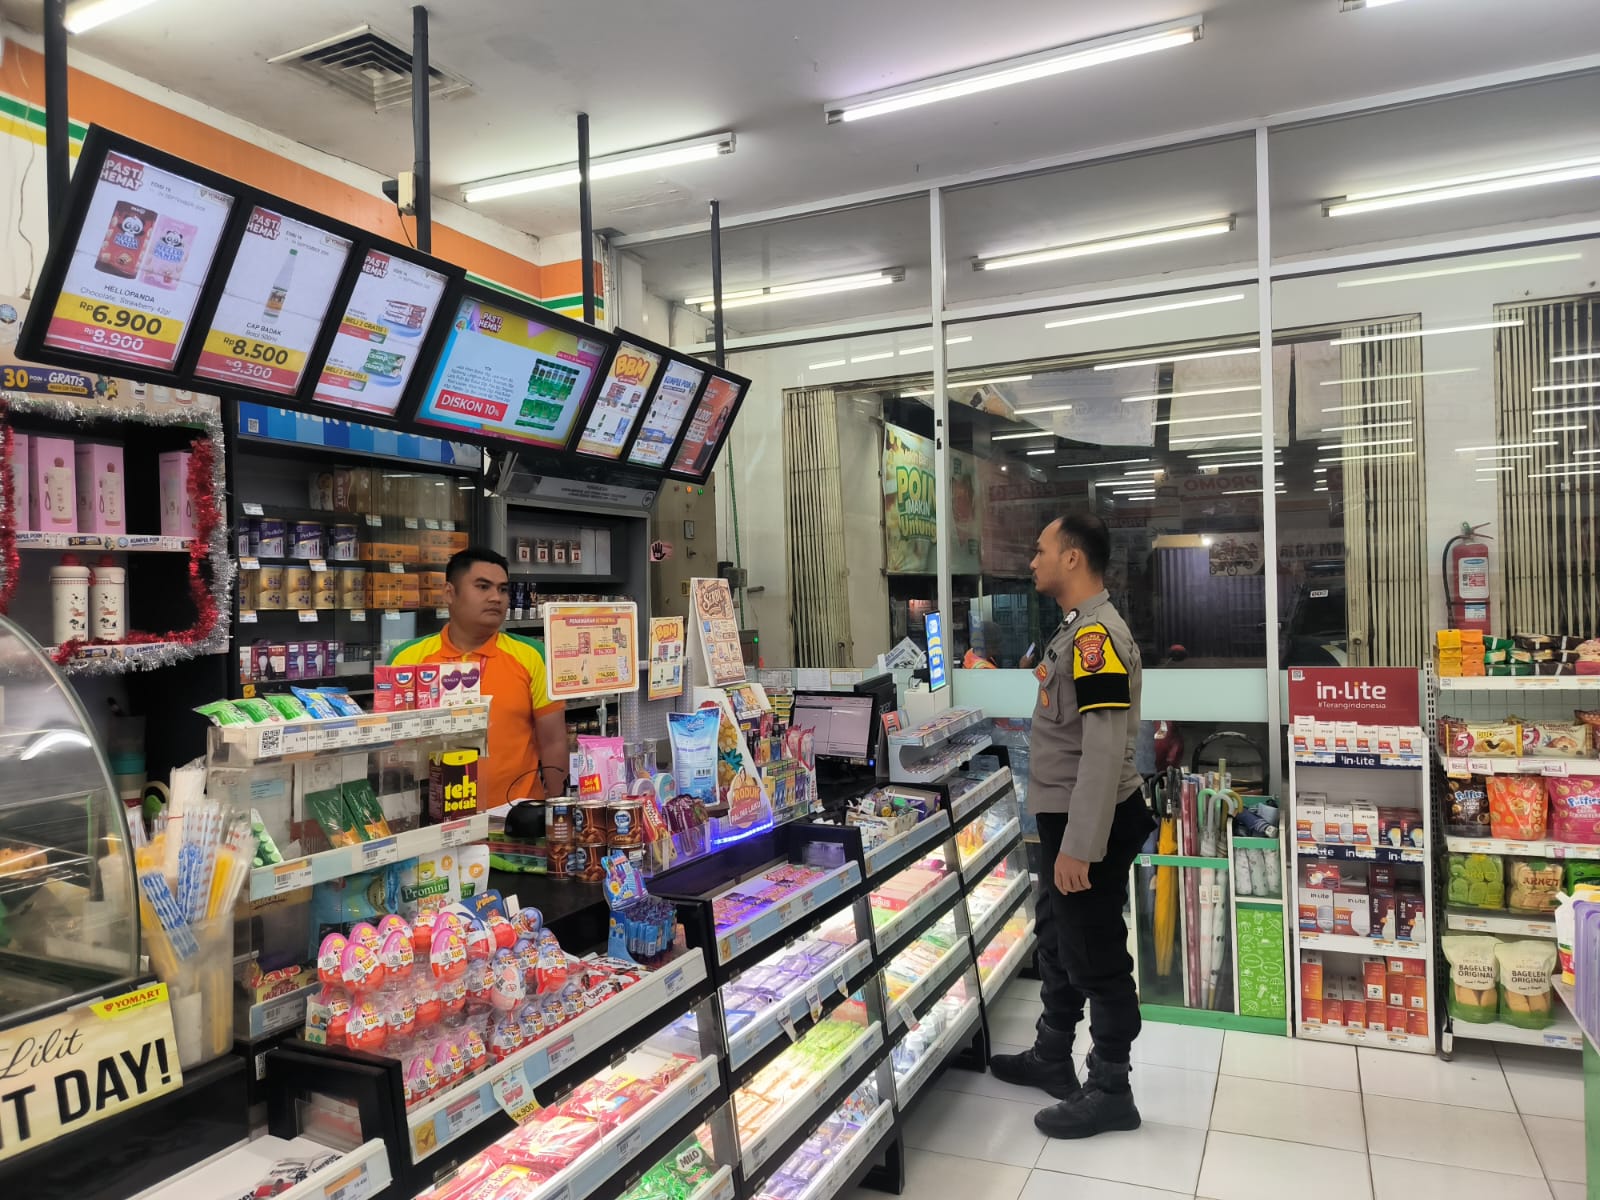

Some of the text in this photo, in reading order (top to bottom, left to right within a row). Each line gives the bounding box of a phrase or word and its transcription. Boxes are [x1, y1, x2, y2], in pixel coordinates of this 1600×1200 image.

[103, 159, 143, 180] PASTI
[100, 169, 143, 190] HEMAT
[253, 214, 280, 228] PASTI
[247, 222, 280, 239] HEMAT
[366, 256, 388, 269] PASTI
[104, 284, 155, 303] HELLOPANDA
[246, 322, 282, 336] CAP BADAK
[616, 354, 649, 381] BBM
[4, 368, 28, 388] 30
[49, 372, 85, 387] GRATIS
[441, 394, 500, 417] DISKON 10%
[655, 622, 678, 642] BBM
[1457, 733, 1469, 751] 5
[1523, 728, 1535, 746] 5
[444, 775, 477, 800] teh
[735, 787, 761, 801] RODUK
[444, 797, 477, 812] kotak
[404, 881, 448, 899] Promina
[1458, 970, 1494, 979] ORIGINAL
[1459, 964, 1493, 972] BAGELEN
[1511, 970, 1546, 978] BAGELEN
[1511, 976, 1546, 984] ORIGINAL
[115, 988, 161, 1013] YOMART
[585, 983, 608, 1000] bueno
[0, 1028, 84, 1079] Lilit
[0, 1037, 171, 1142] T DAY!
[678, 1150, 700, 1168] MILO
